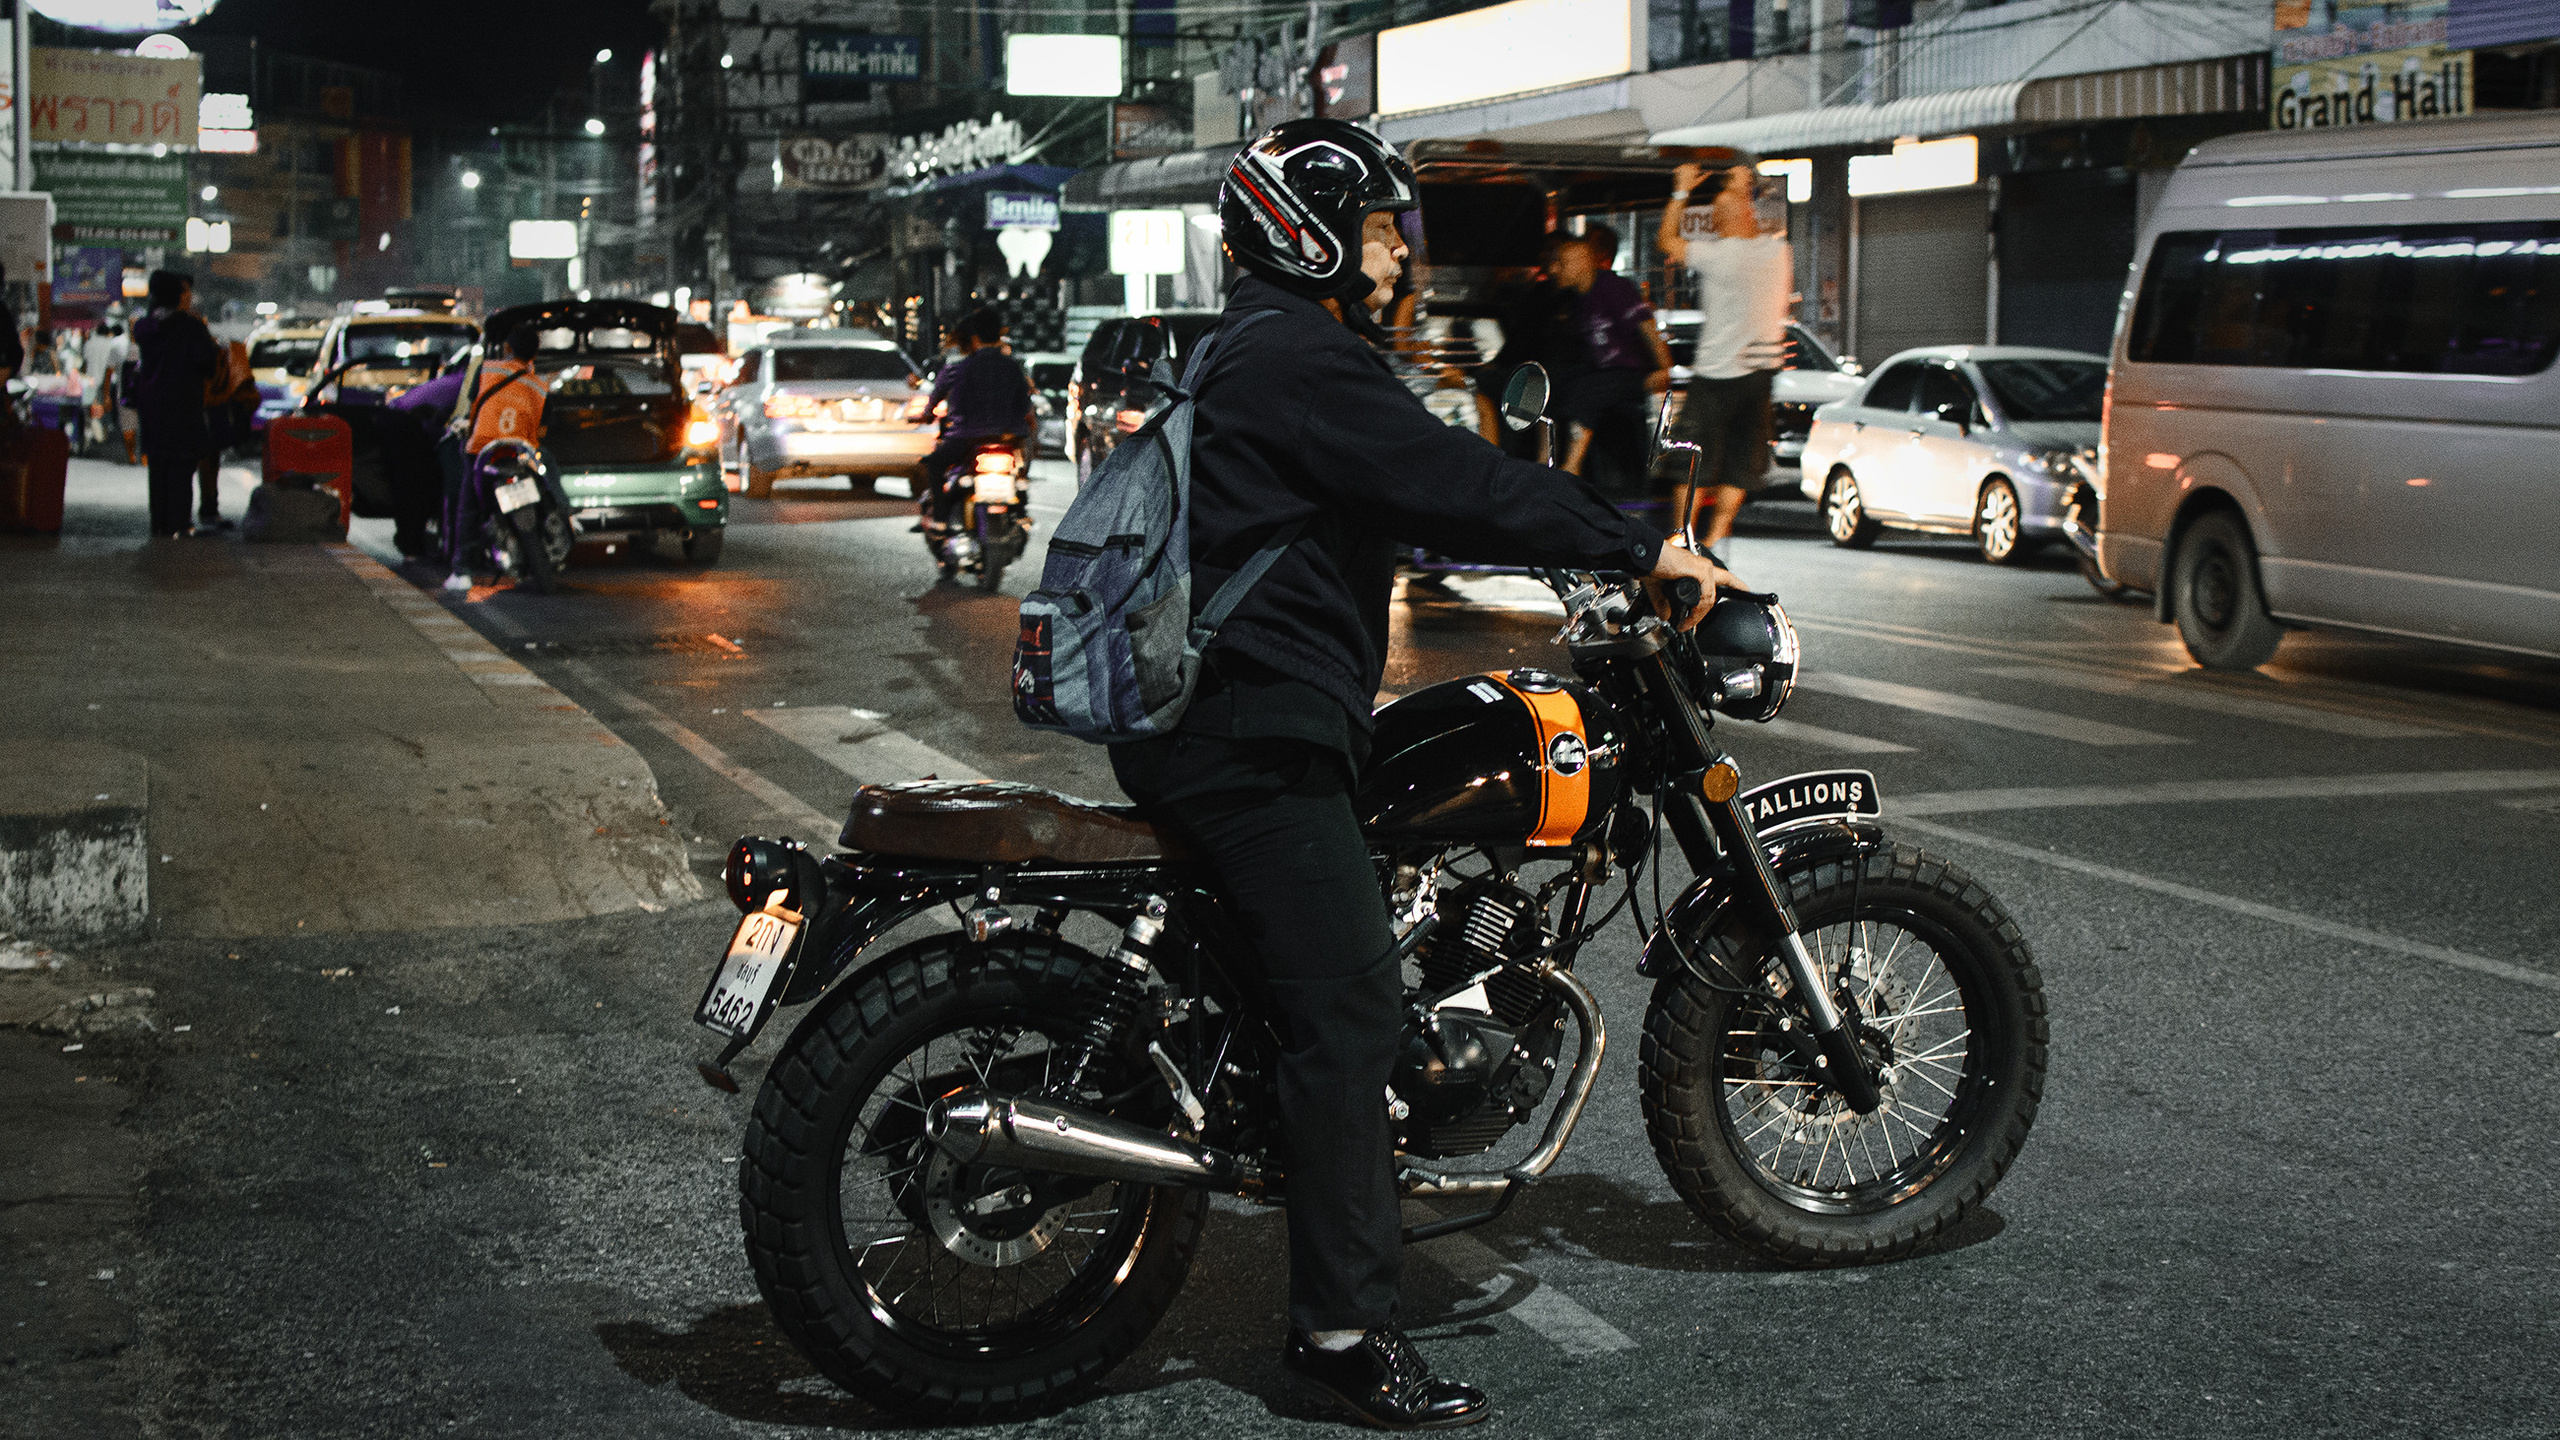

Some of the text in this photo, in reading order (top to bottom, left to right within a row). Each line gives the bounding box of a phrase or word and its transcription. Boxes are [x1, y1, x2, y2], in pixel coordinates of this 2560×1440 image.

[2277, 59, 2464, 130] Grand Hall
[991, 196, 1057, 219] Smile
[498, 406, 517, 434] 8
[709, 988, 753, 1032] 5462
